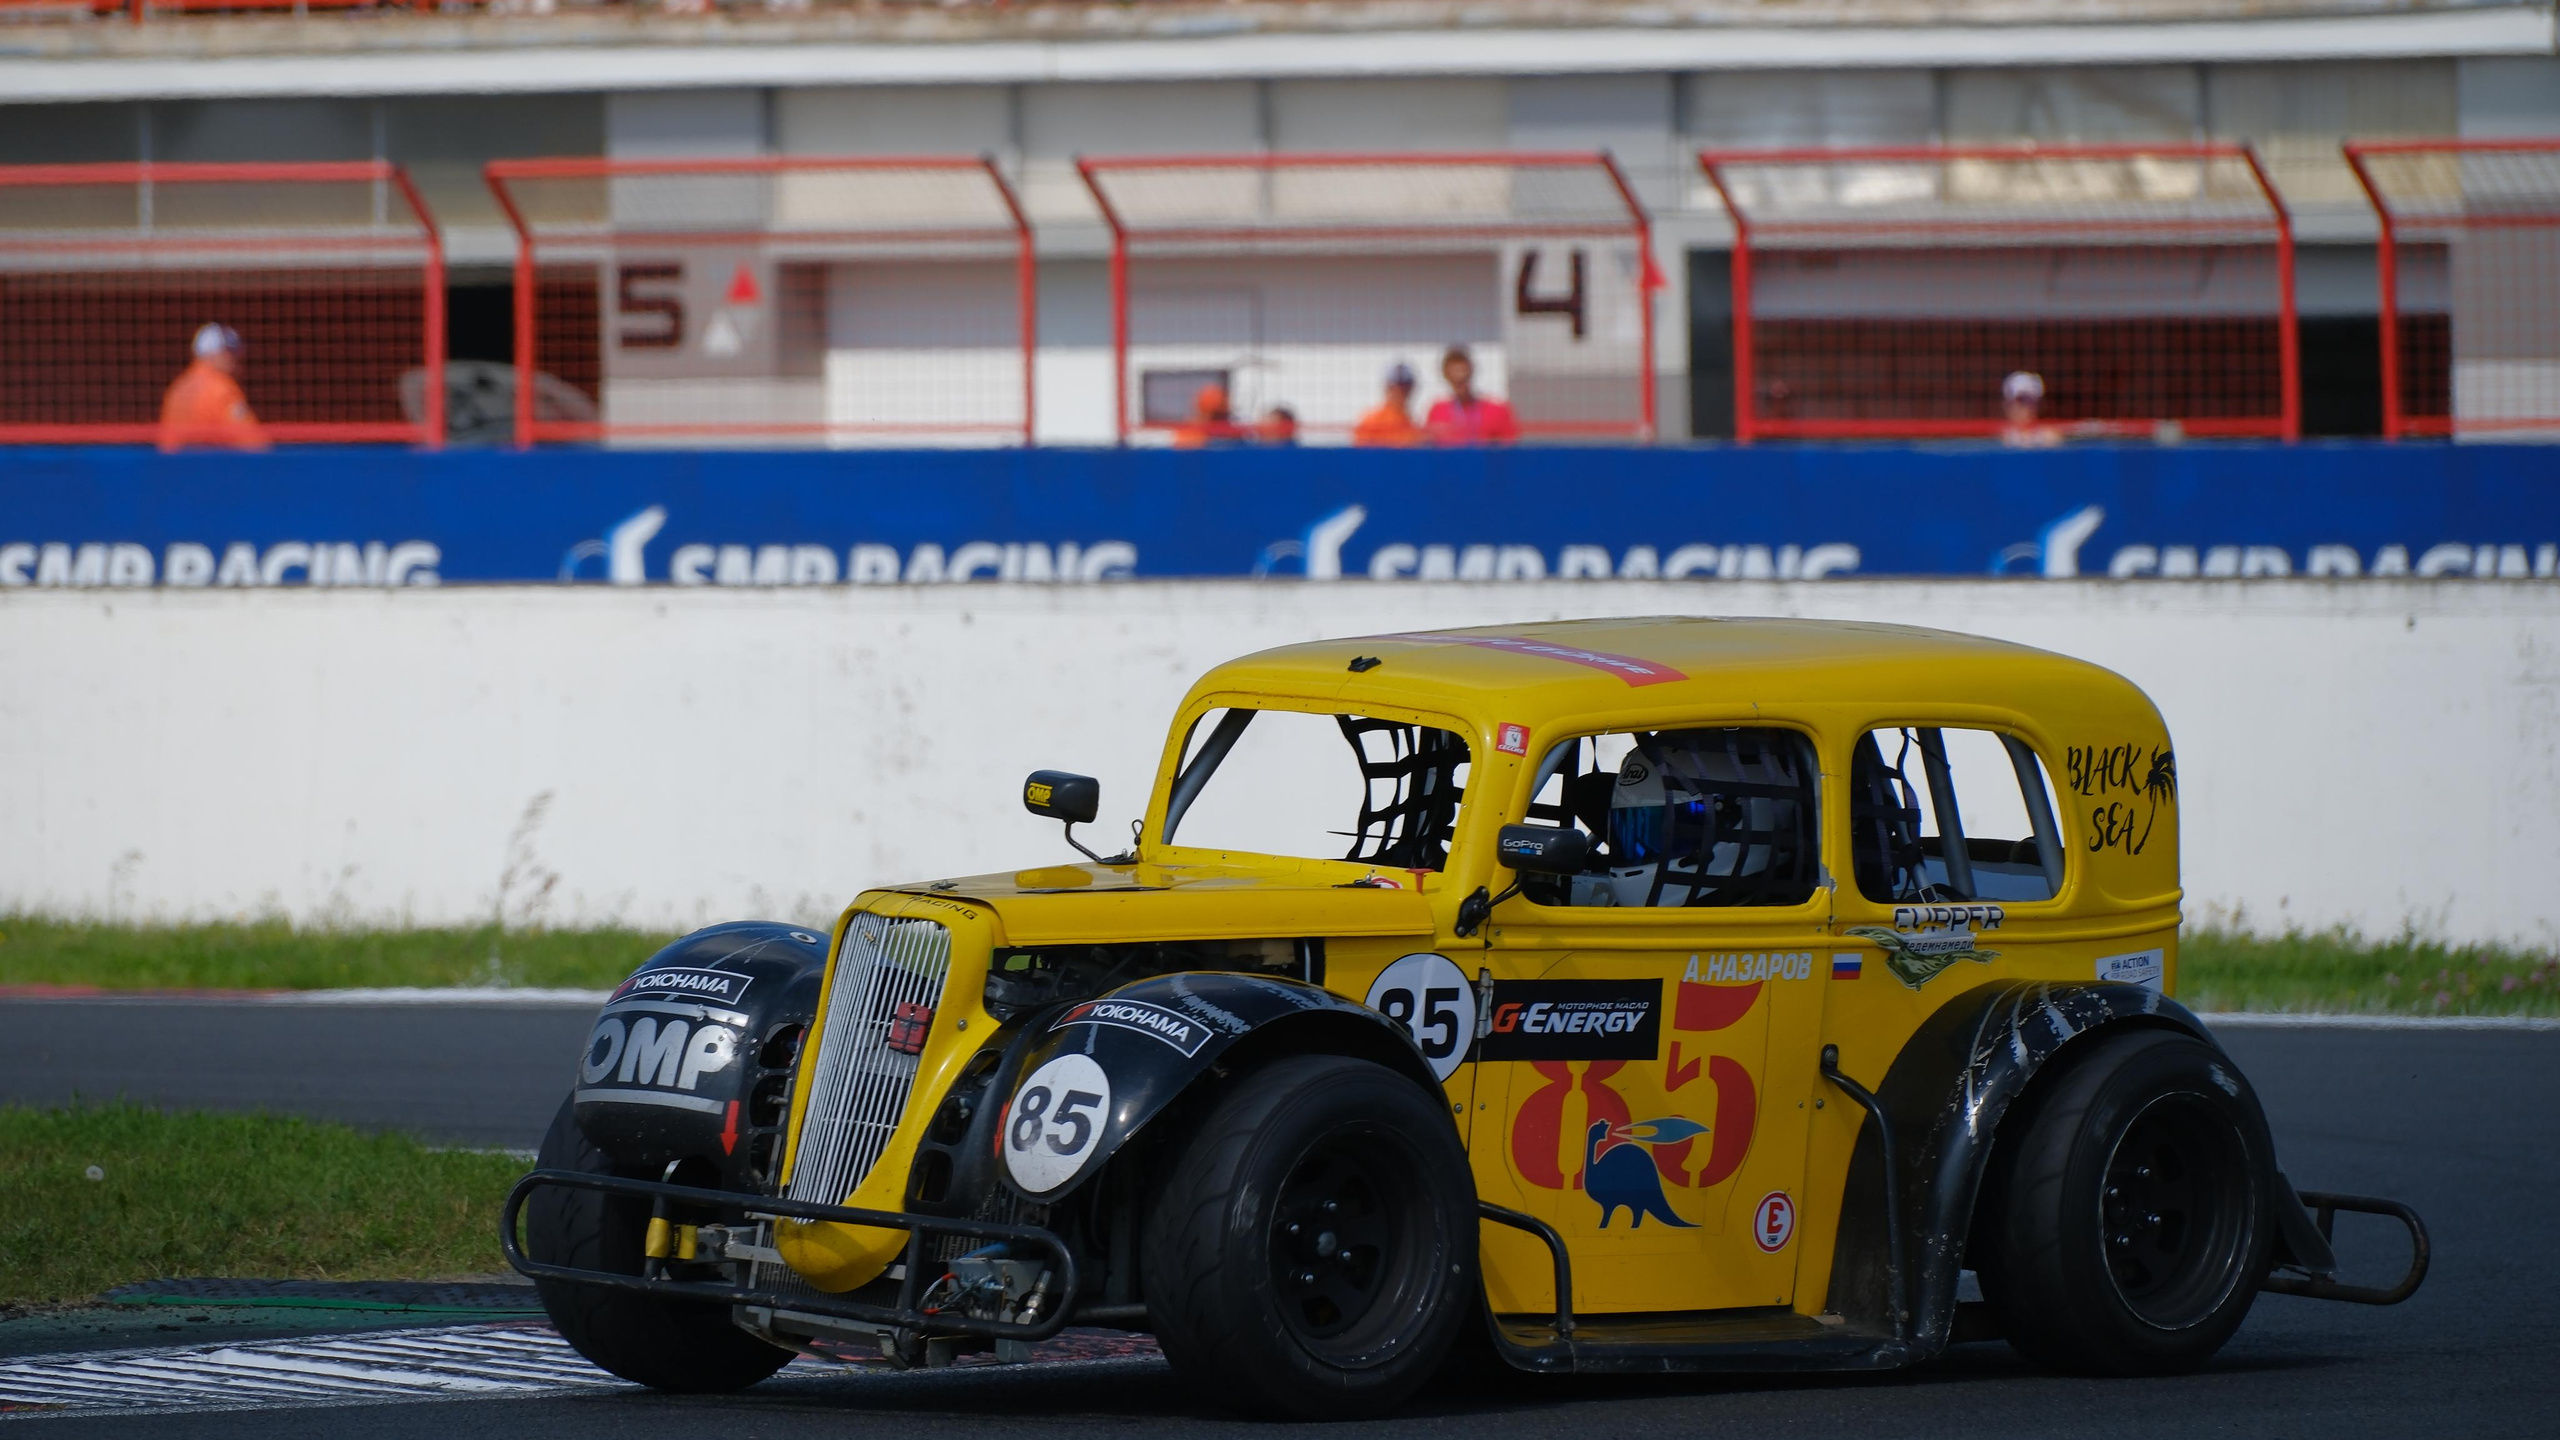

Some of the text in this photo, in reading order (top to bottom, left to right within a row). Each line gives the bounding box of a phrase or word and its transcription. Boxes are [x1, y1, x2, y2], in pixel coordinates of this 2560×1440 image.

[618, 262, 682, 348] 5
[1516, 251, 1585, 338] 4
[2067, 743, 2142, 796] BLACK
[1027, 786, 1051, 803] OMP
[1503, 838, 1544, 850] GoPro
[2089, 802, 2134, 856] SEA
[908, 896, 978, 921] RACING
[1682, 953, 1813, 983] А.НАЗАРОВ
[2122, 956, 2150, 970] ACTION
[632, 973, 730, 994] YOKOHAMA
[1557, 1001, 1650, 1010] МОТОРНОЕ МАСЛО
[1089, 1004, 1191, 1043] YOKOHAMA
[582, 1016, 738, 1091] OMP
[1011, 1085, 1104, 1156] 85
[1767, 1201, 1785, 1234] E
